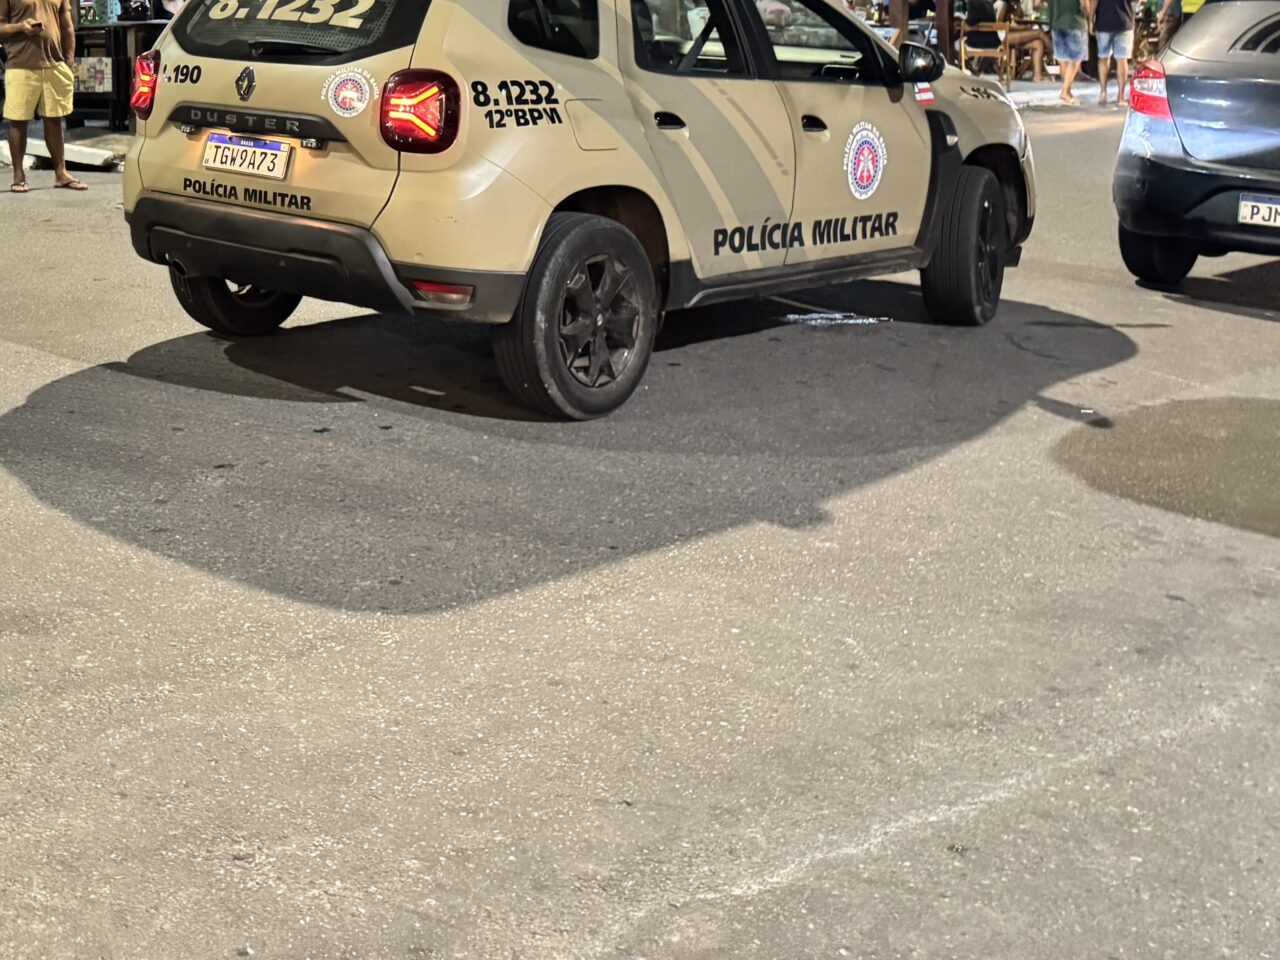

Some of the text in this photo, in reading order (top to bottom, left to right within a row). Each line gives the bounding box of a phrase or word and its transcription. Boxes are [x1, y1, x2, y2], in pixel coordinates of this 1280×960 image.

[471, 80, 560, 107] 8.1232
[190, 109, 300, 132] DUSTER
[212, 145, 278, 173] TGW9A73
[183, 178, 312, 211] POLÍCIA MILITAR
[713, 212, 899, 256] POLÍCIA MILITAR
